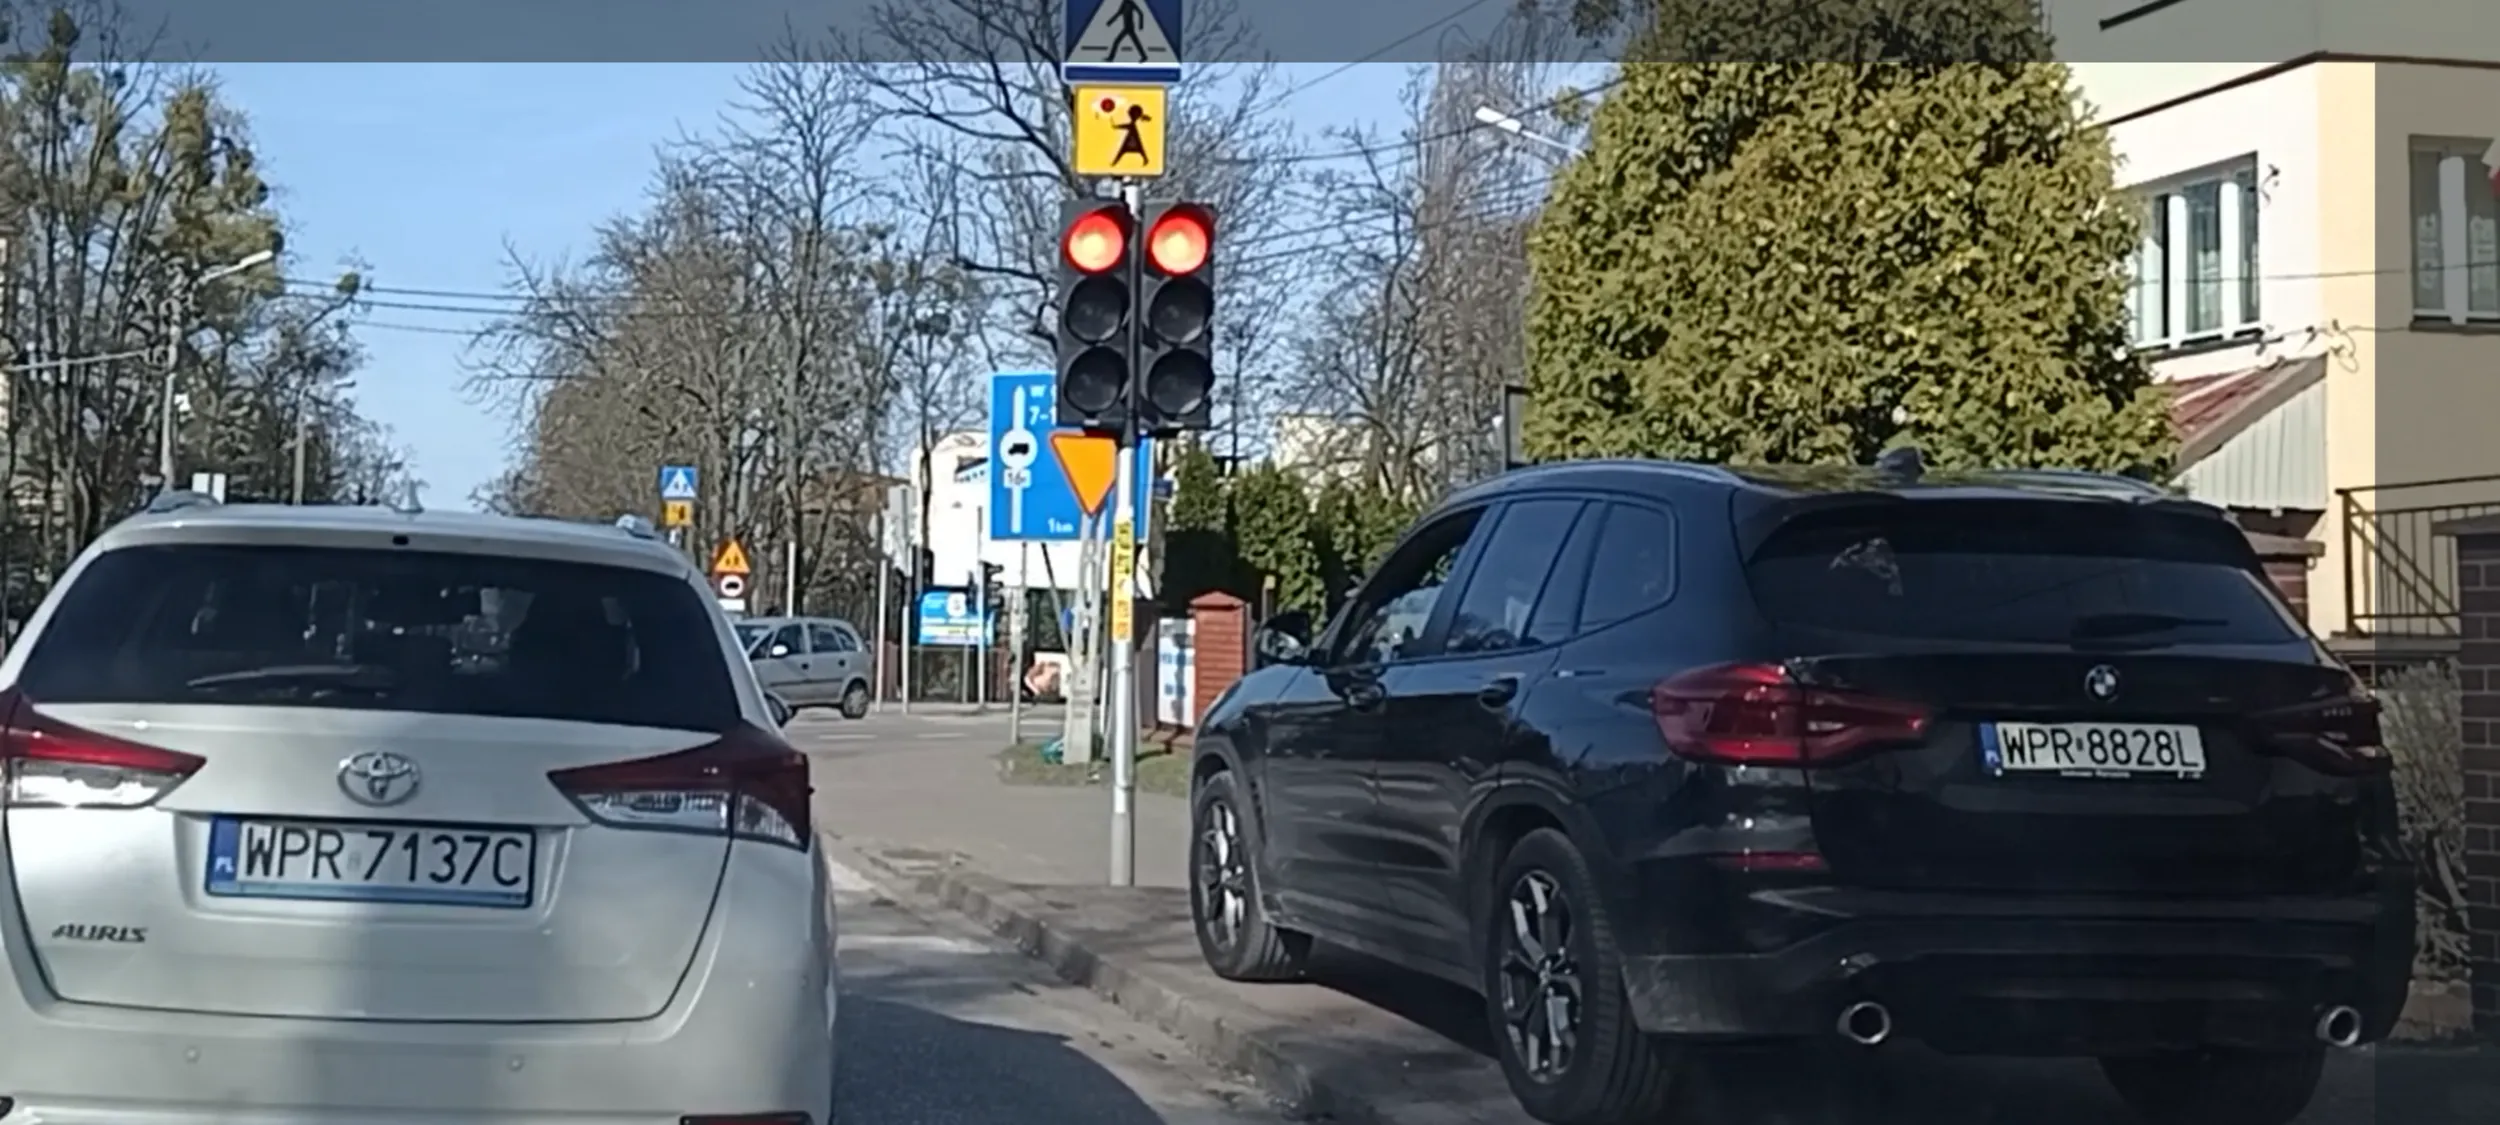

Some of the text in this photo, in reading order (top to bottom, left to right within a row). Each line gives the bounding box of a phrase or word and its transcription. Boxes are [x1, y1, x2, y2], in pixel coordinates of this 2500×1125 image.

[1029, 405, 1057, 425] 7-1
[2002, 728, 2199, 767] WPR 8828L
[246, 826, 523, 887] WPR 7137C
[51, 923, 148, 943] AURIS
